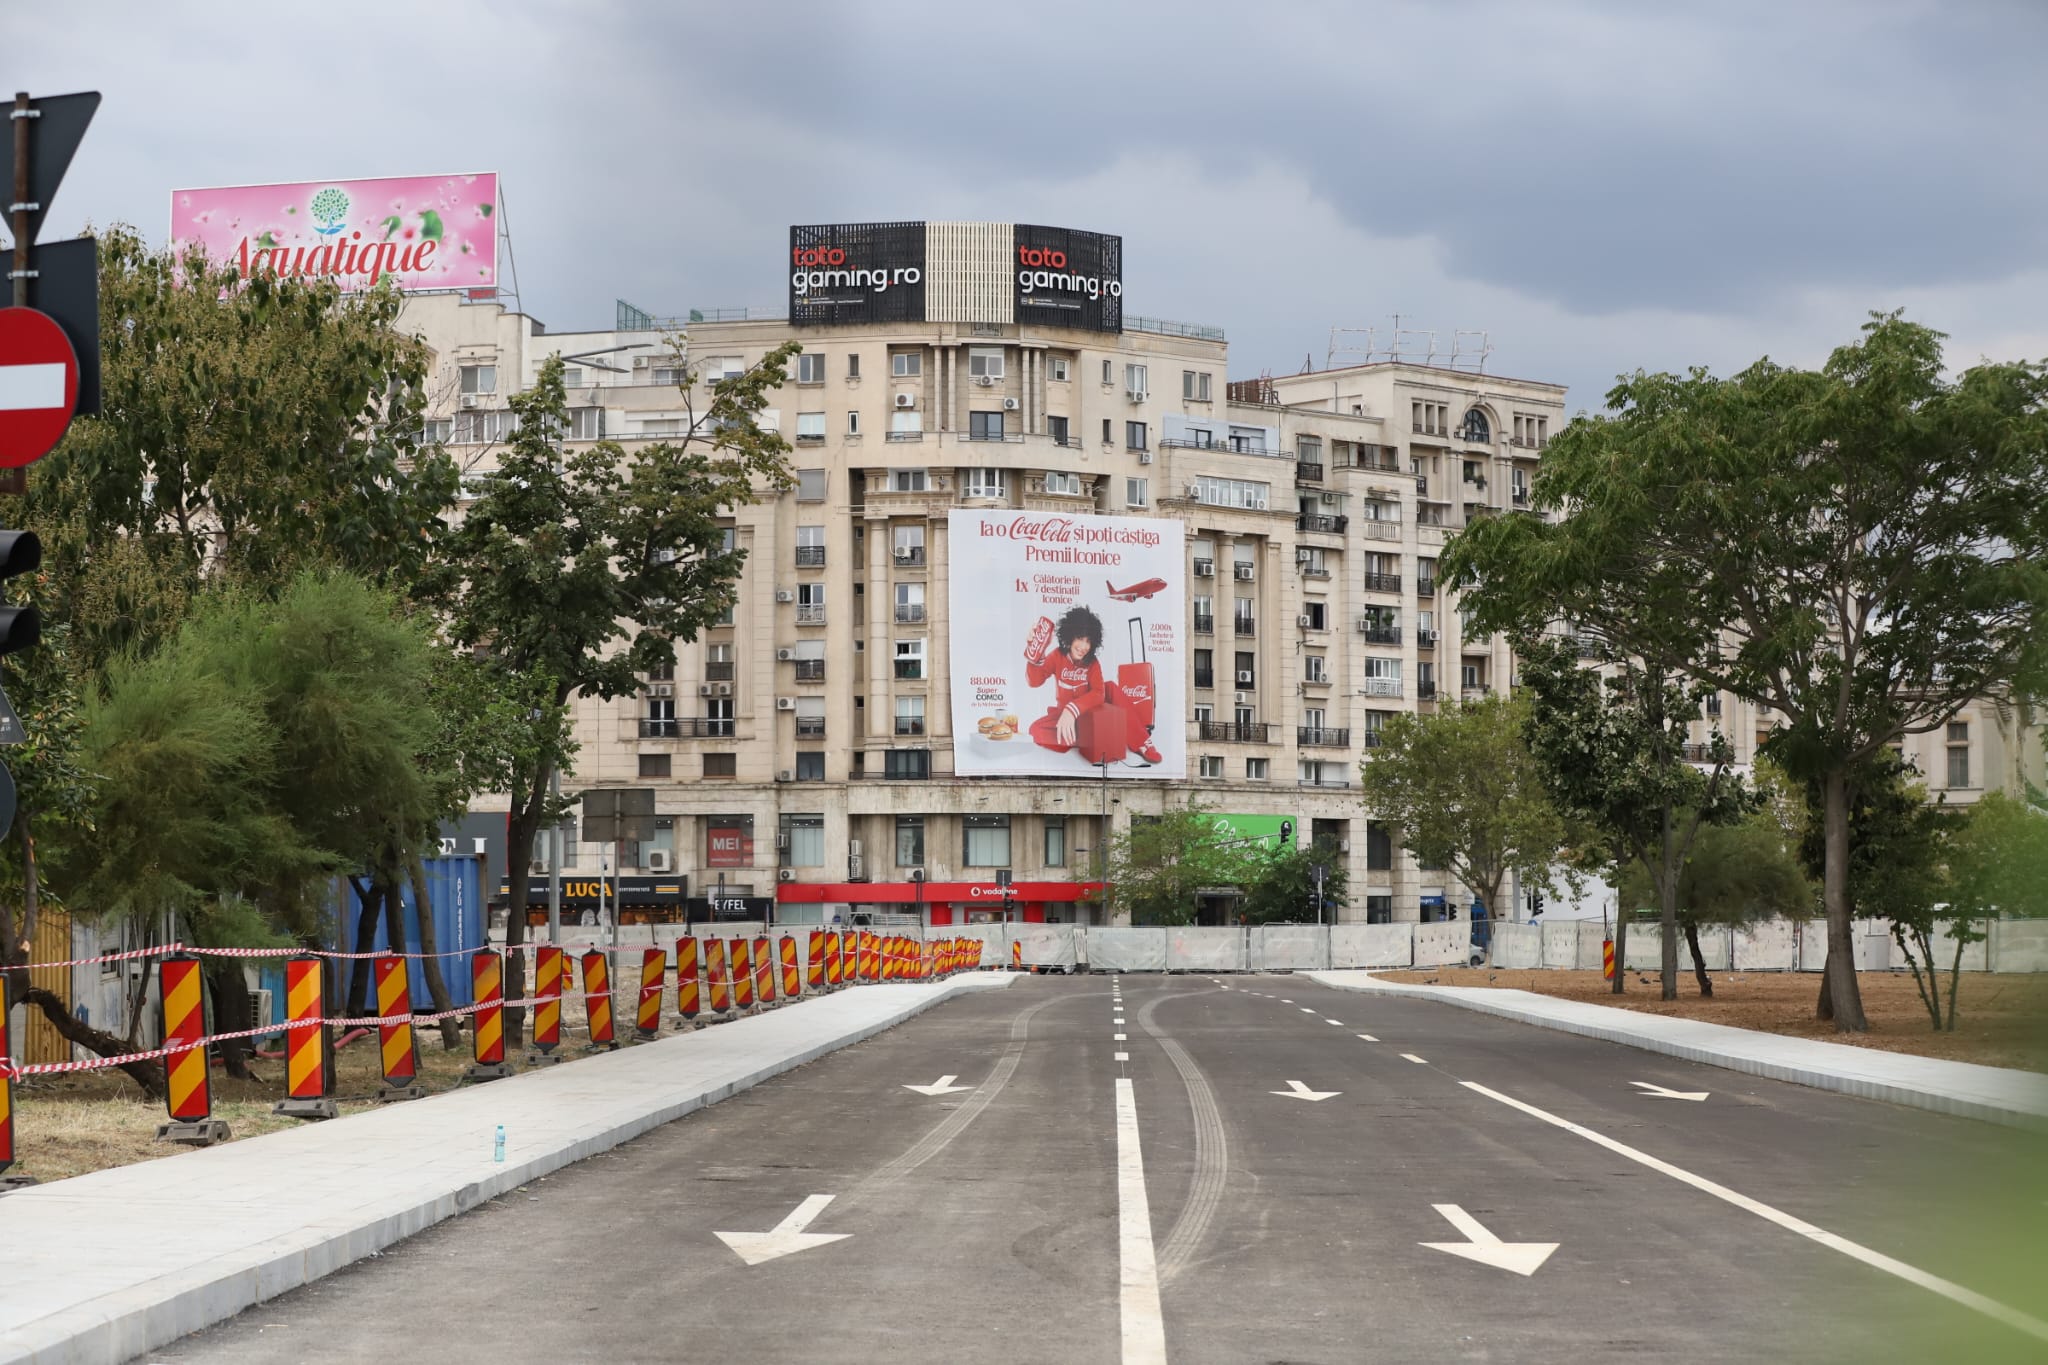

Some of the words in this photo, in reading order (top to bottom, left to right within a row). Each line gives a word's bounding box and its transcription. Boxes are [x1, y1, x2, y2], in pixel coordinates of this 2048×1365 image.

[231, 231, 437, 286] Aquatique
[793, 245, 846, 267] toto
[1019, 245, 1067, 269] toto
[792, 264, 921, 295] gaming.ro
[1019, 269, 1122, 300] gaming.ro
[996, 524, 1006, 537] o
[1009, 516, 1074, 543] Coca-Cola
[1026, 545, 1072, 563] Premii
[1073, 547, 1121, 566] Iconice
[1015, 578, 1029, 593] 1x
[1034, 584, 1040, 593] 7
[1042, 594, 1073, 604] Iconice
[970, 676, 1007, 686] 88.000x
[713, 837, 740, 850] MEI
[565, 882, 613, 897] LUCA
[982, 887, 1018, 896] vodane
